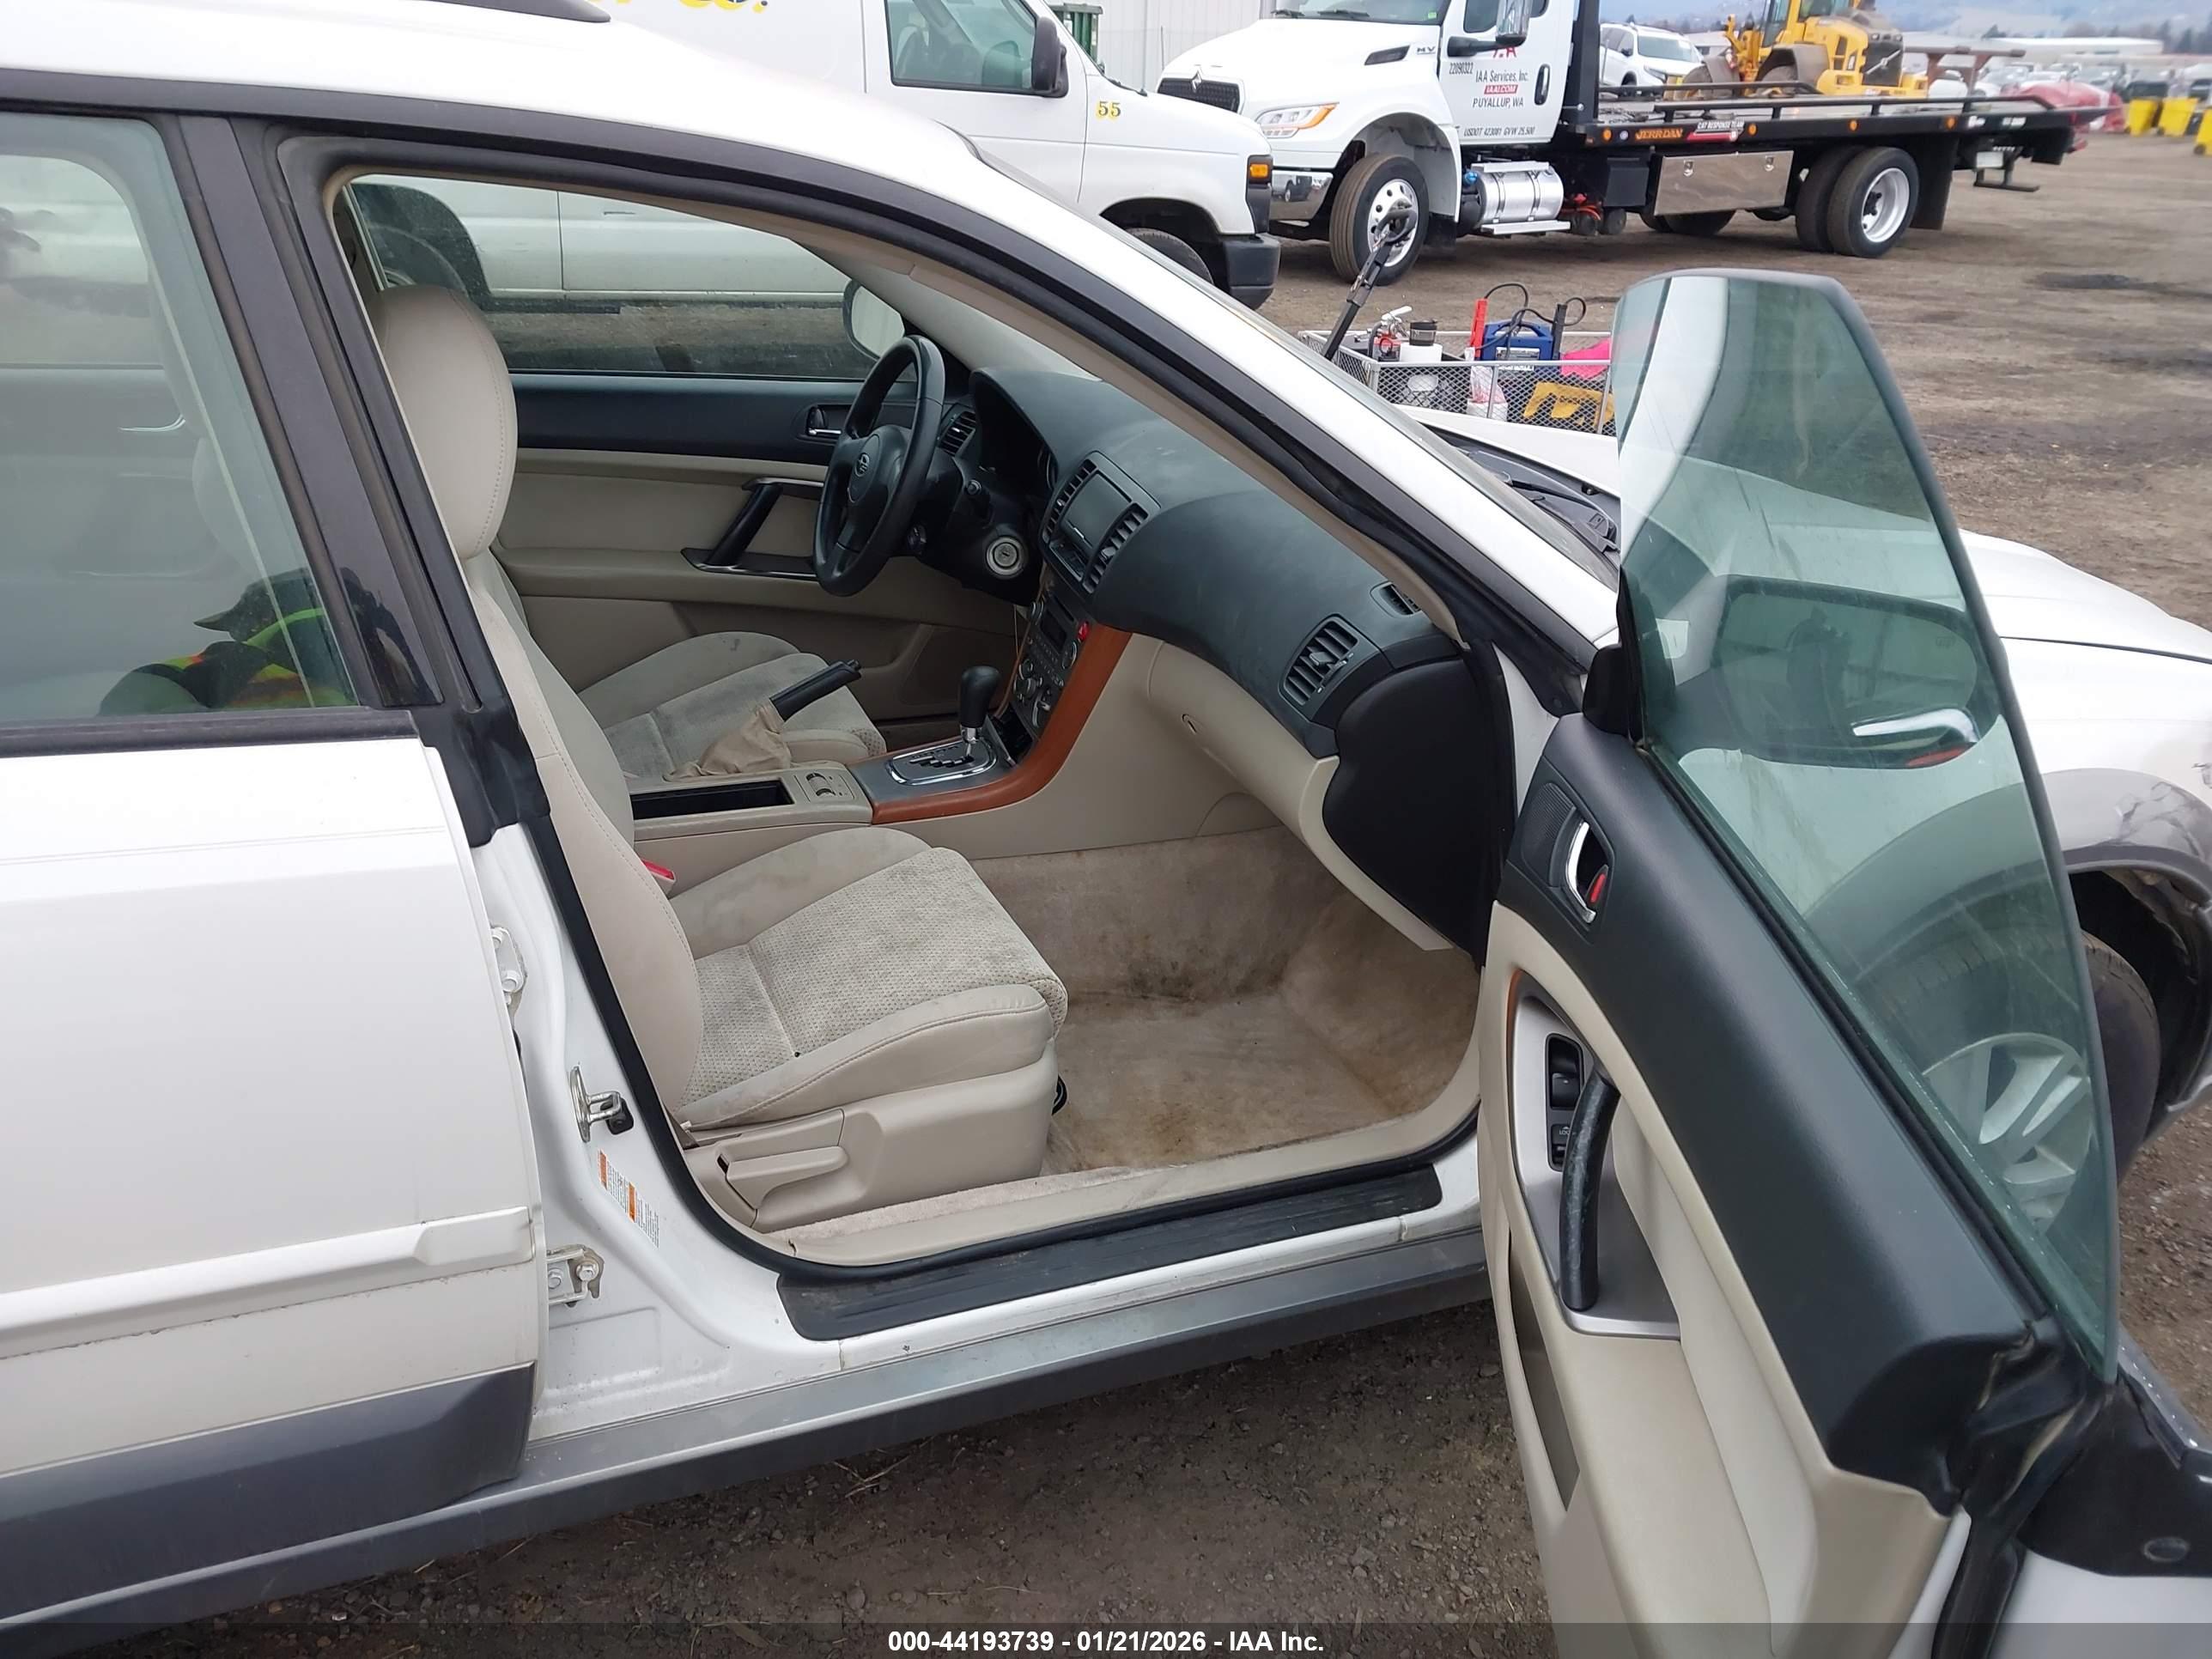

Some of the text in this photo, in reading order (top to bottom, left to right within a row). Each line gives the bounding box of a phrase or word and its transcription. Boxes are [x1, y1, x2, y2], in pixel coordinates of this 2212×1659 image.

[1475, 70, 1488, 82] IAA
[1098, 100, 1121, 118] 55
[1472, 96, 1524, 109] PUYALLUP, WA
